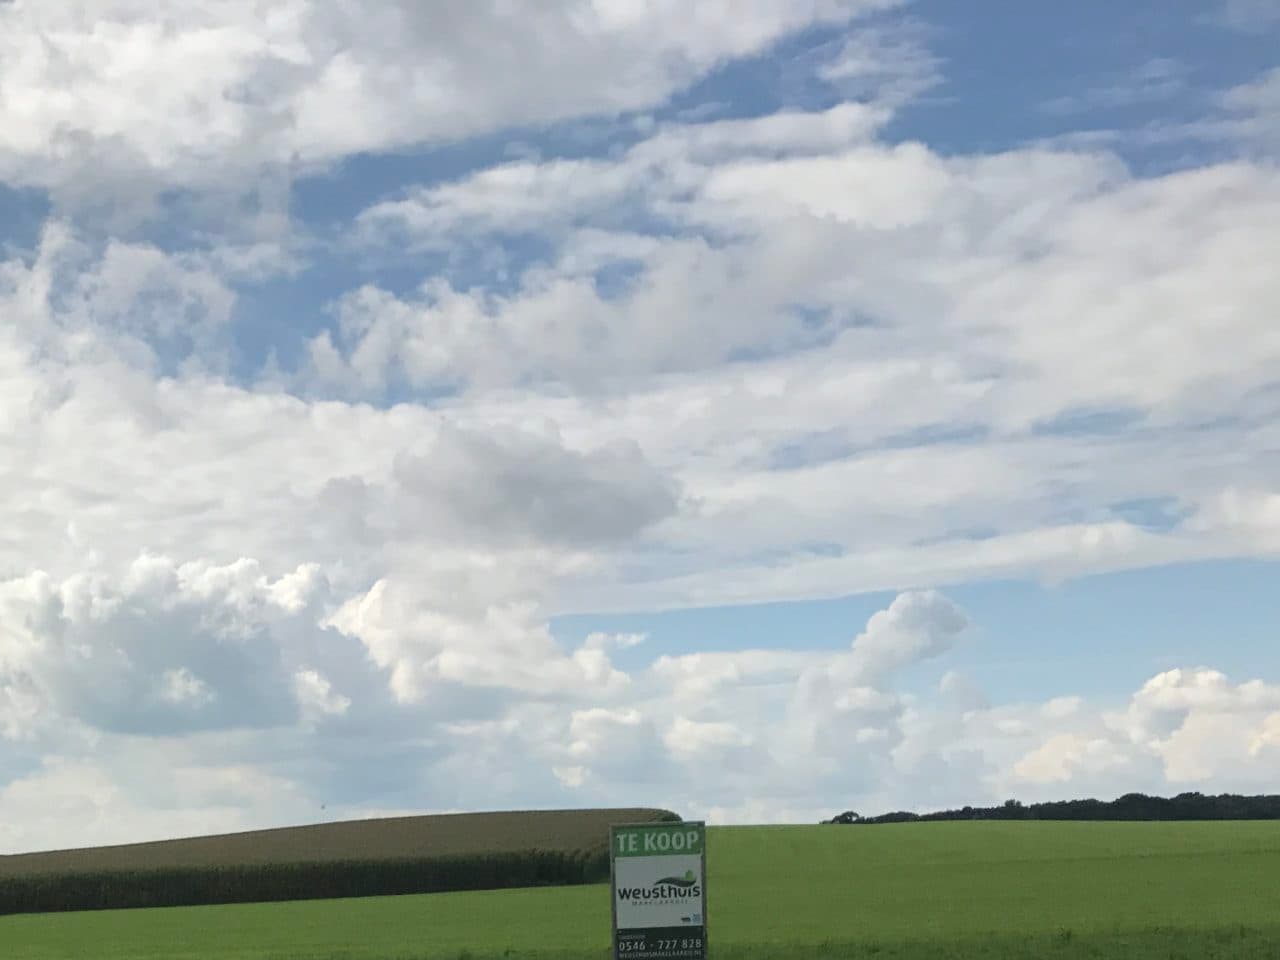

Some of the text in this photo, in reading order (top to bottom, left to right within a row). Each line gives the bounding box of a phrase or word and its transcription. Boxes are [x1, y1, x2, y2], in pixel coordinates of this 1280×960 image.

[617, 831, 699, 852] TE KOOP
[618, 886, 701, 900] weusthuis
[619, 941, 646, 951] 0546
[681, 939, 702, 949] 828
